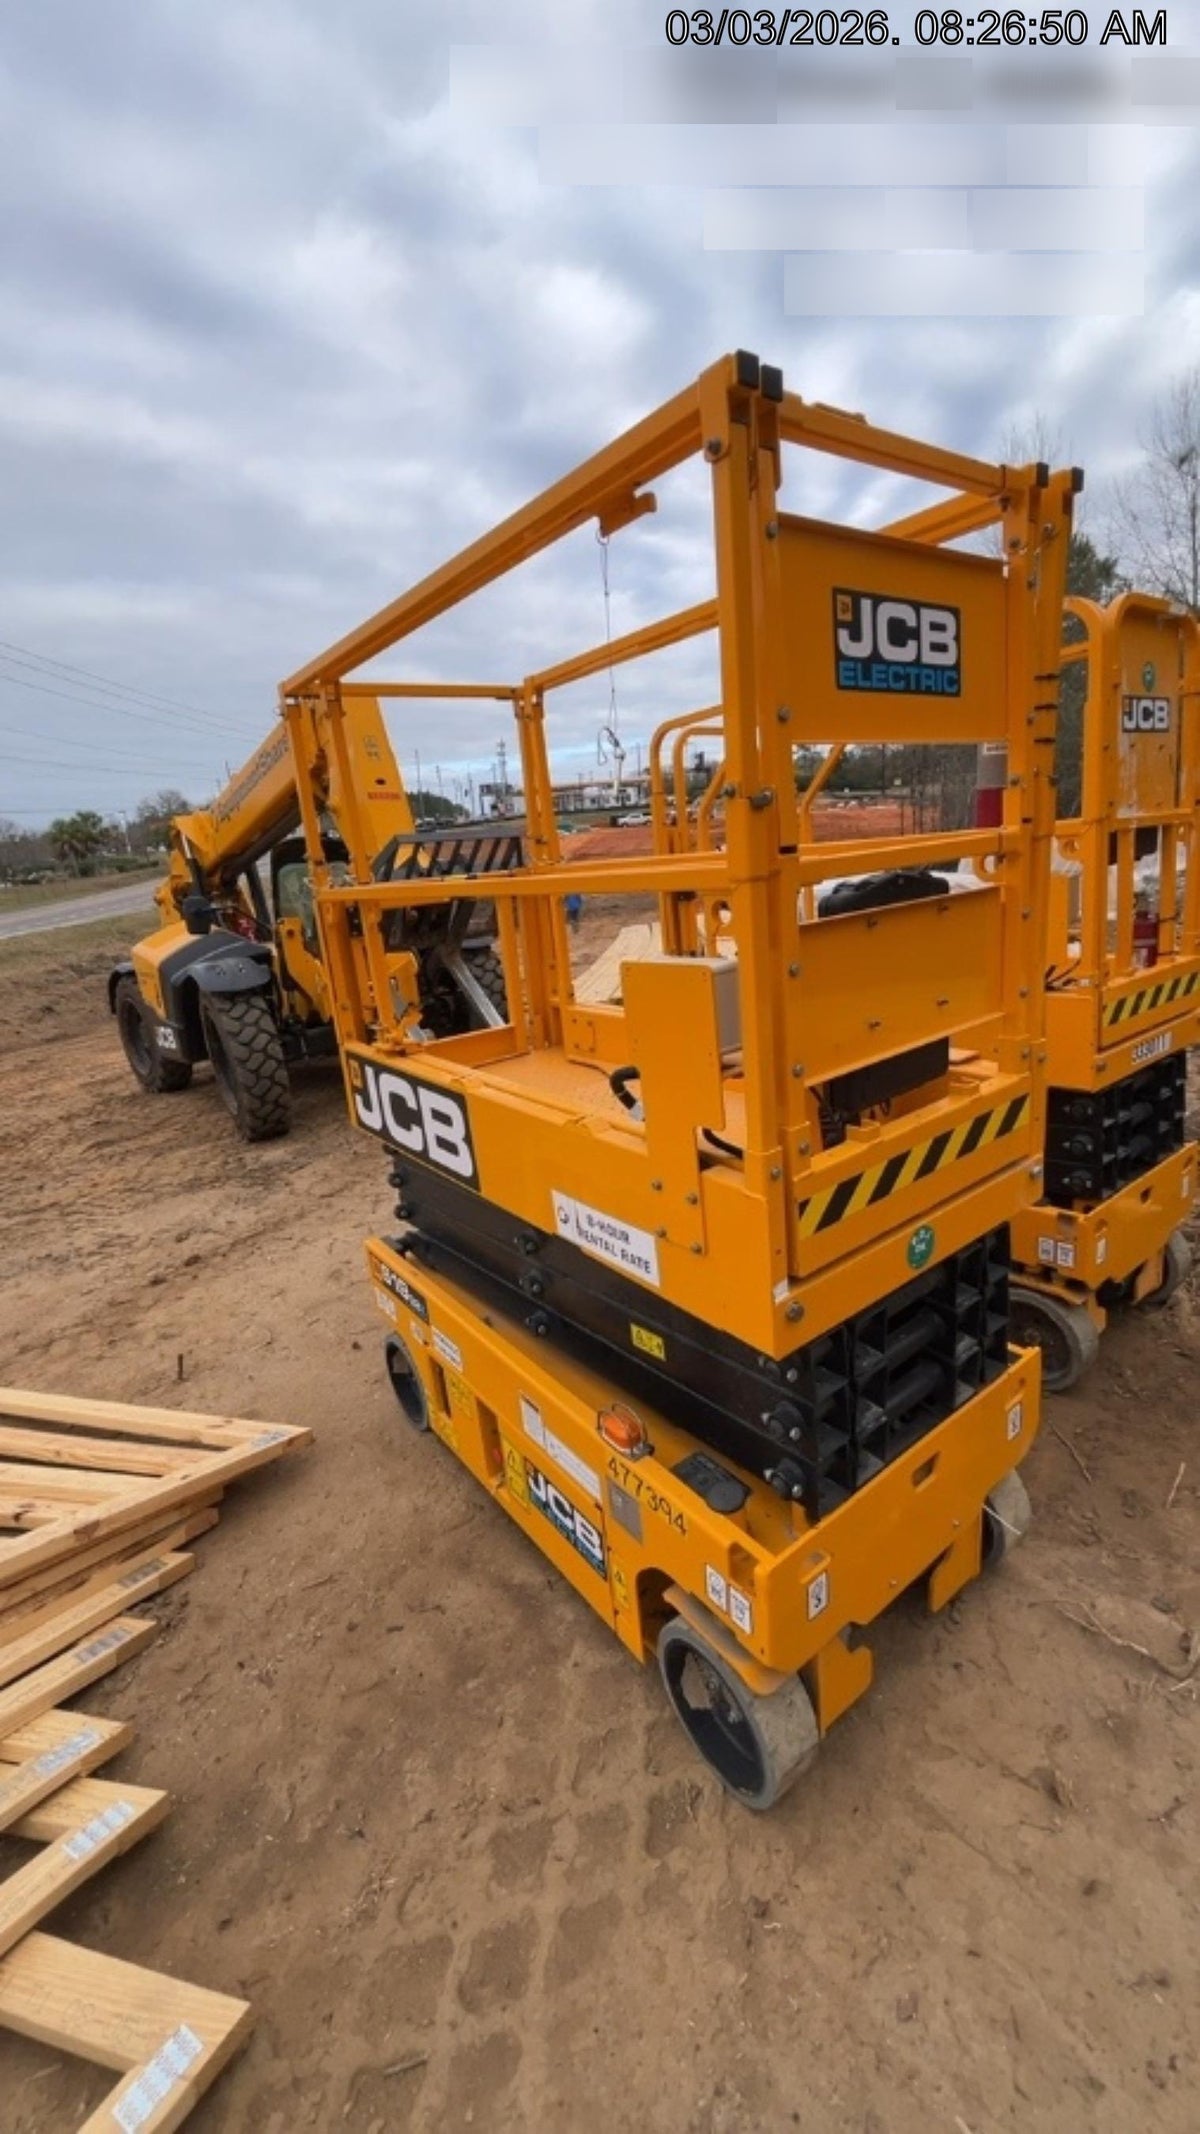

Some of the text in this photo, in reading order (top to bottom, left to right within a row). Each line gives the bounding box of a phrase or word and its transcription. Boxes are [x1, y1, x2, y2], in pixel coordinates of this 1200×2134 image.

[837, 597, 959, 666] JCB
[839, 660, 958, 693] ELECTRIC
[1123, 698, 1168, 730] JCB
[155, 1026, 177, 1049] JCB
[355, 1064, 473, 1177] JCB
[577, 1228, 651, 1274] RENTAL RATE
[528, 1470, 604, 1562] JCB
[608, 1456, 687, 1536] 477394
